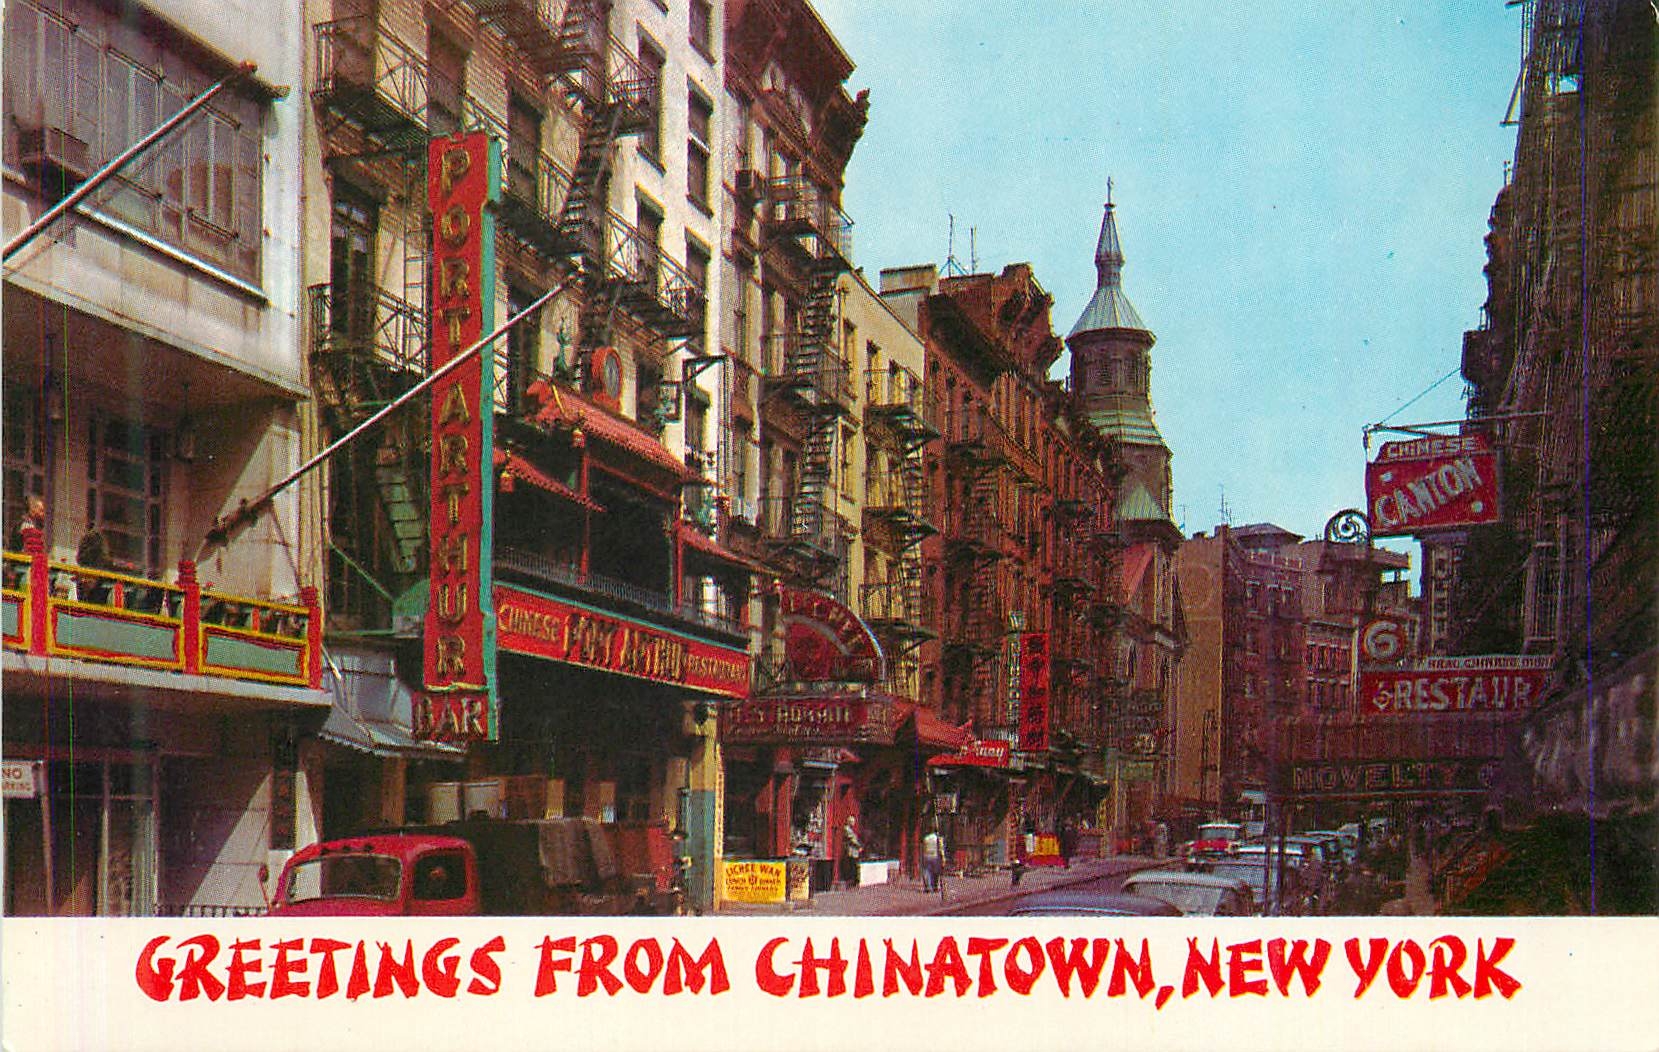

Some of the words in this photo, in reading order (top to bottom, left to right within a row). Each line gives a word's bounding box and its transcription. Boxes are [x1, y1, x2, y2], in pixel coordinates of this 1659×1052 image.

[439, 148, 471, 351] PORT
[1388, 437, 1476, 458] CHINESE
[1375, 456, 1482, 526] CANTON
[436, 383, 471, 677] ARTHUR
[498, 603, 560, 642] CHINESE
[1293, 762, 1460, 790] NOVELTY
